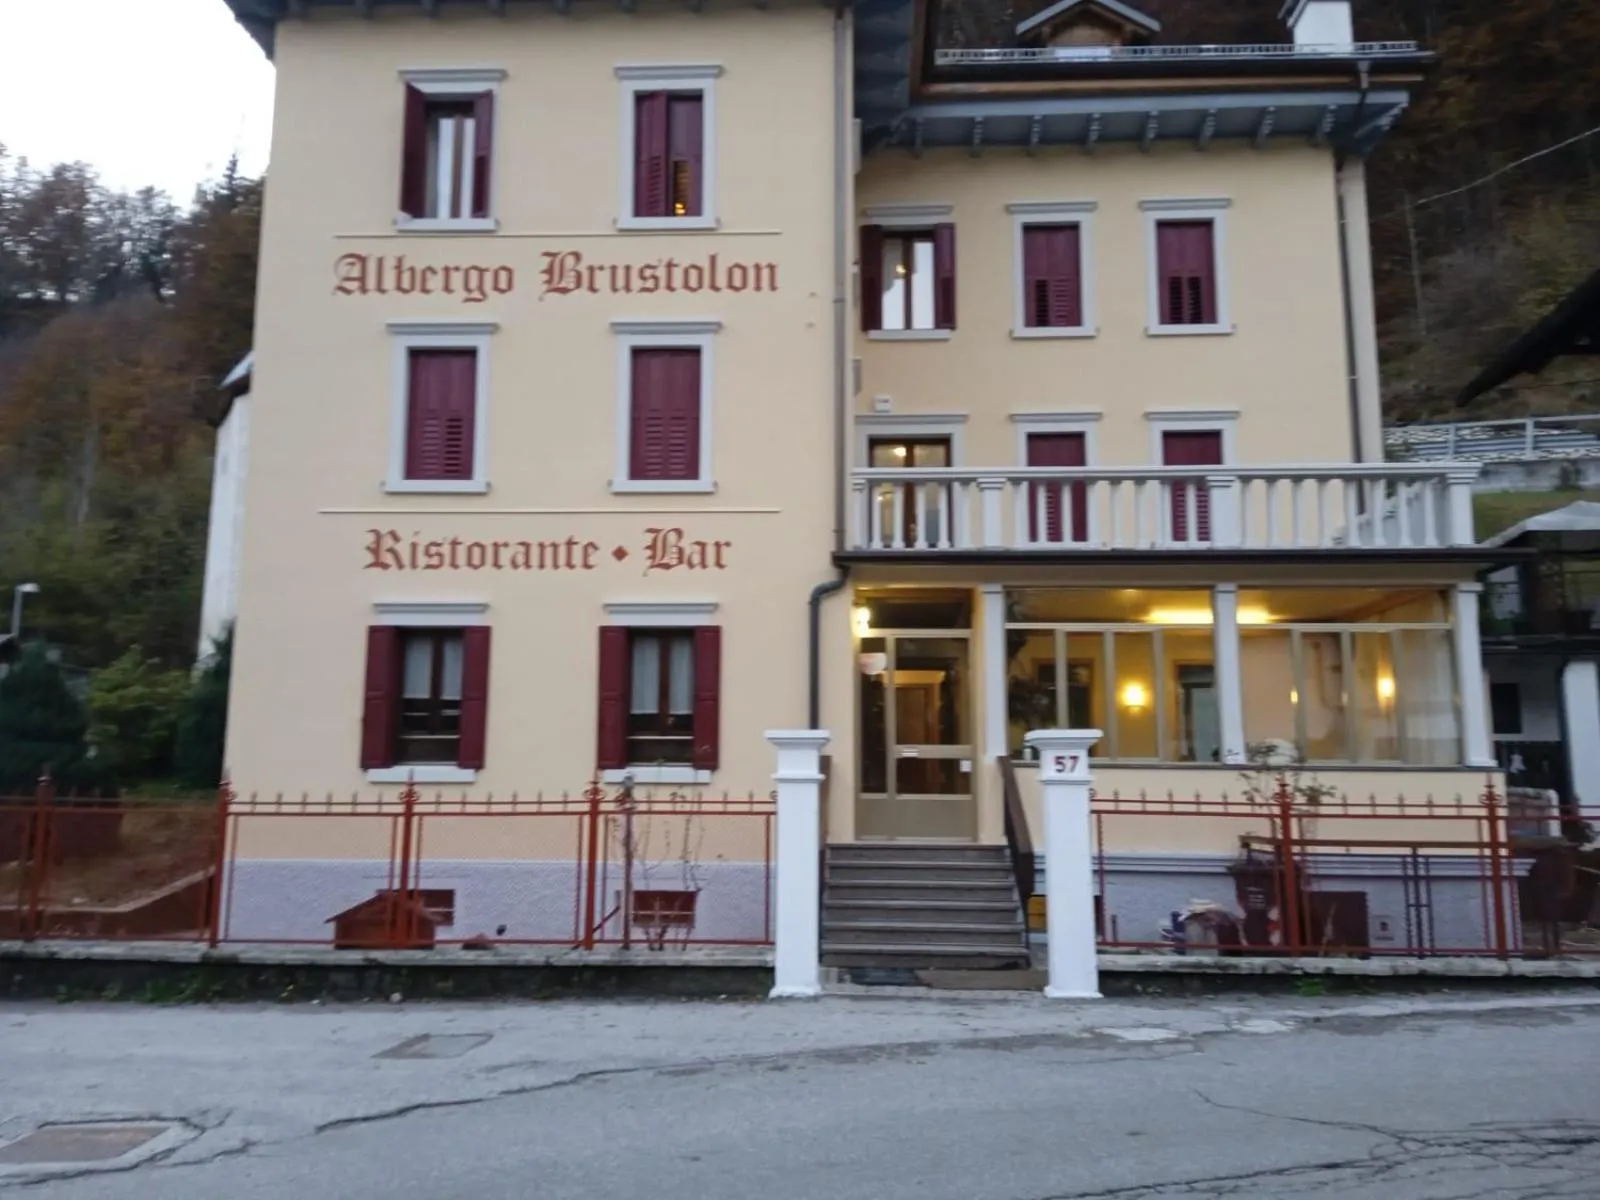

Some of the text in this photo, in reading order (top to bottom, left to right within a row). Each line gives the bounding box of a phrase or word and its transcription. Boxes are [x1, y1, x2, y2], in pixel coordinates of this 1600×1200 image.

[332, 250, 779, 303] Albergo Brustolon
[364, 527, 732, 577] Ristorante Bar
[1054, 755, 1079, 773] 57
